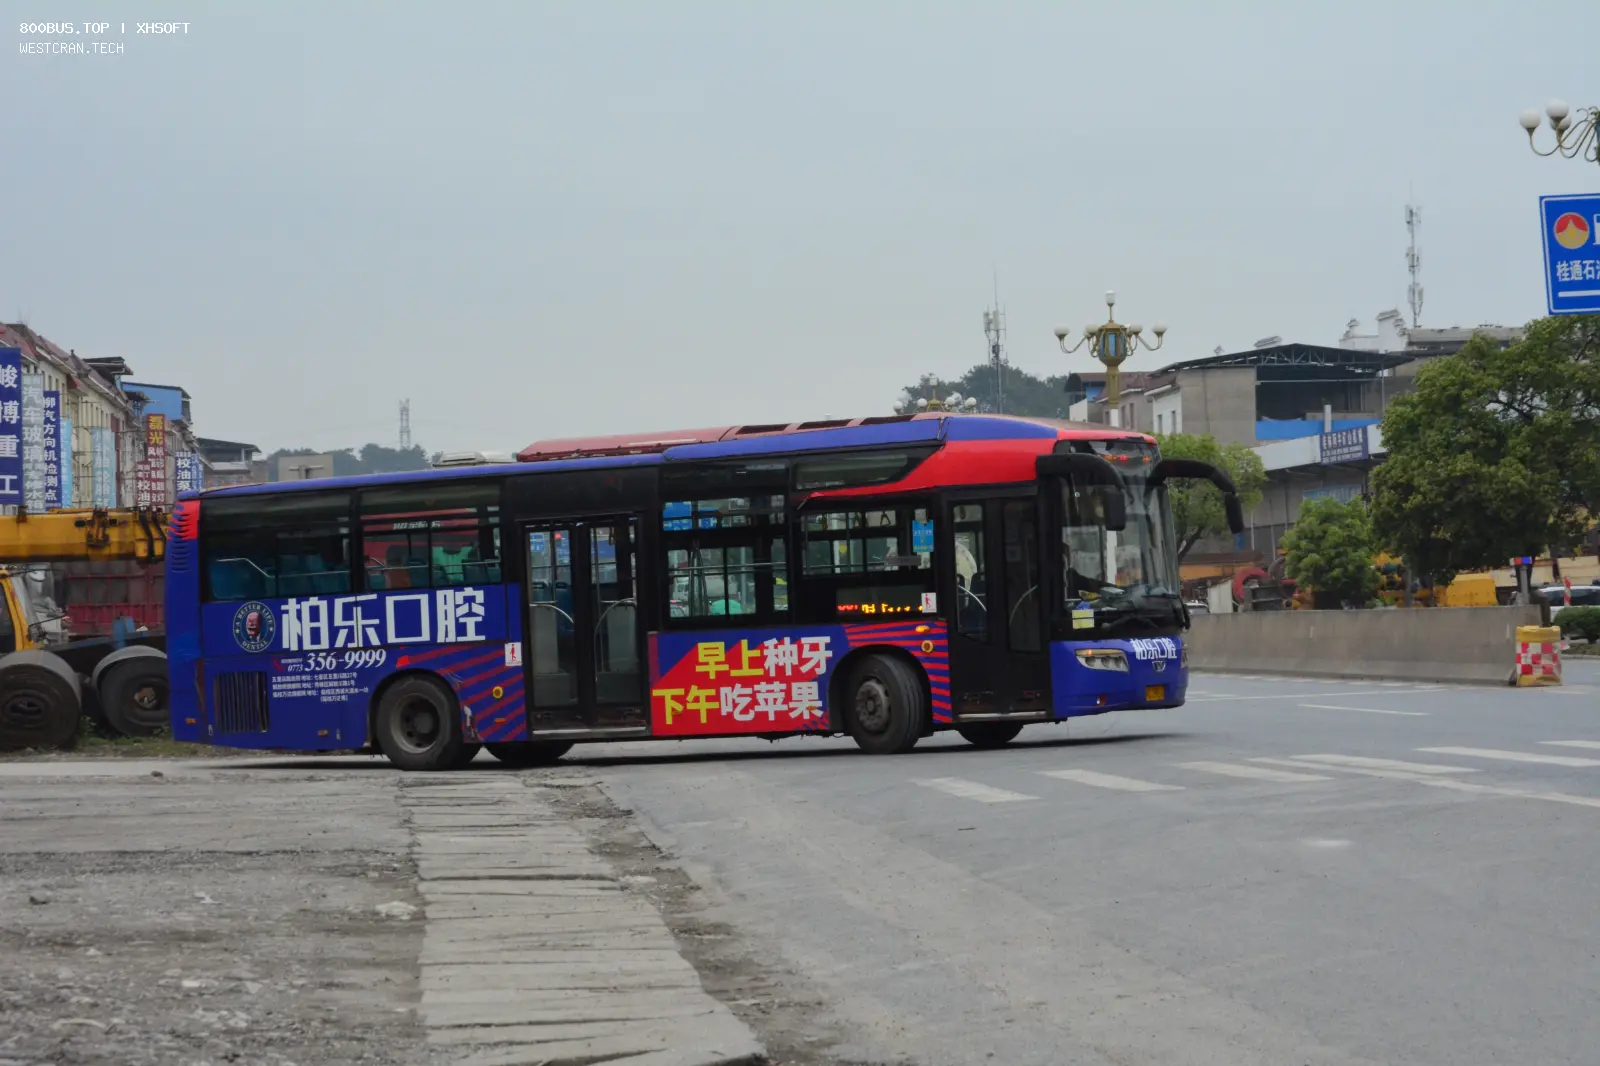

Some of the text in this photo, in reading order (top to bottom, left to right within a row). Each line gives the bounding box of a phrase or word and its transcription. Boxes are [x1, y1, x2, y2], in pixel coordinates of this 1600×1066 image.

[281, 587, 486, 651] 柏乐口腔
[305, 649, 387, 672] 356-9999
[695, 636, 833, 680] 早上种牙
[1130, 637, 1178, 660] 柏乐口腔
[652, 681, 824, 725] 下午吃苹果
